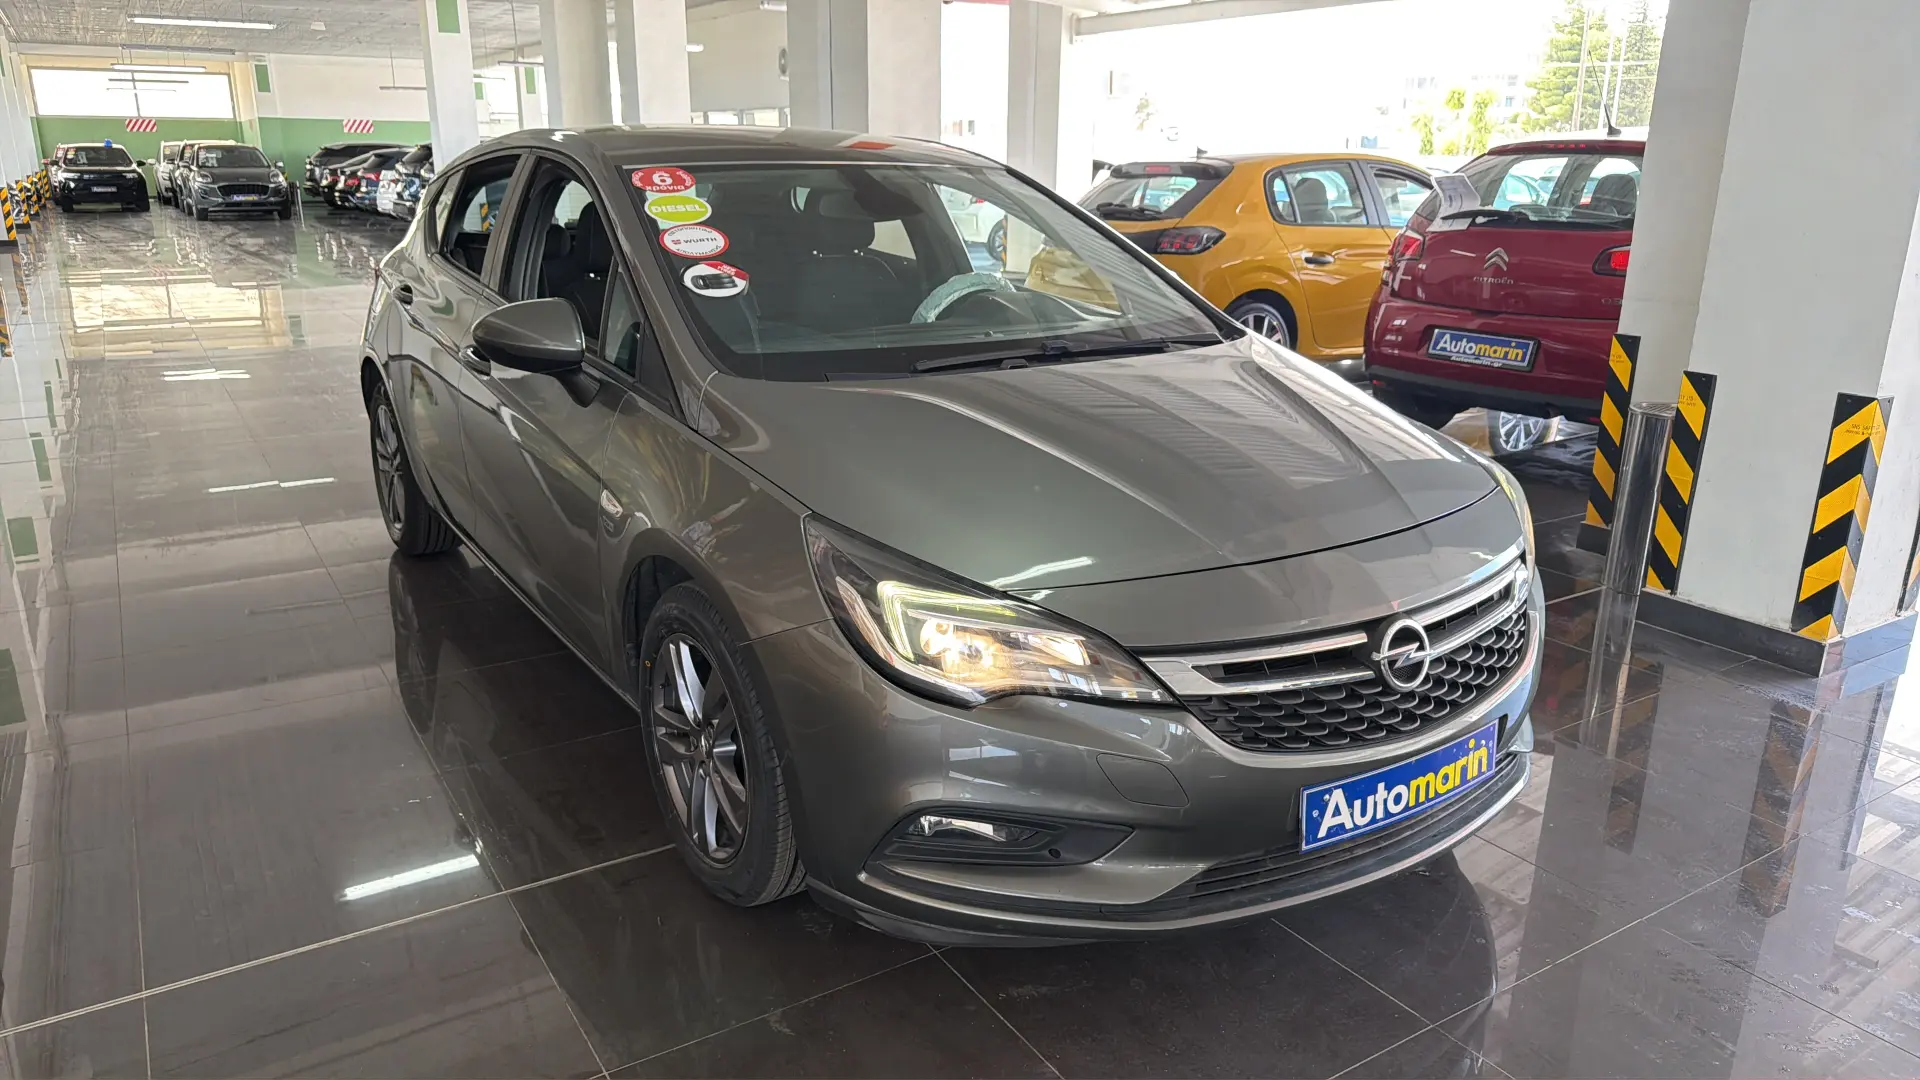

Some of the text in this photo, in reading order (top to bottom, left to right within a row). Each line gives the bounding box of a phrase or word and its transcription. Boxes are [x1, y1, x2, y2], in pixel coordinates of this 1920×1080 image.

[652, 172, 673, 186] 6
[651, 204, 706, 213] DIESEL
[1436, 333, 1524, 361] Automarin
[1317, 738, 1488, 838] Automarin
